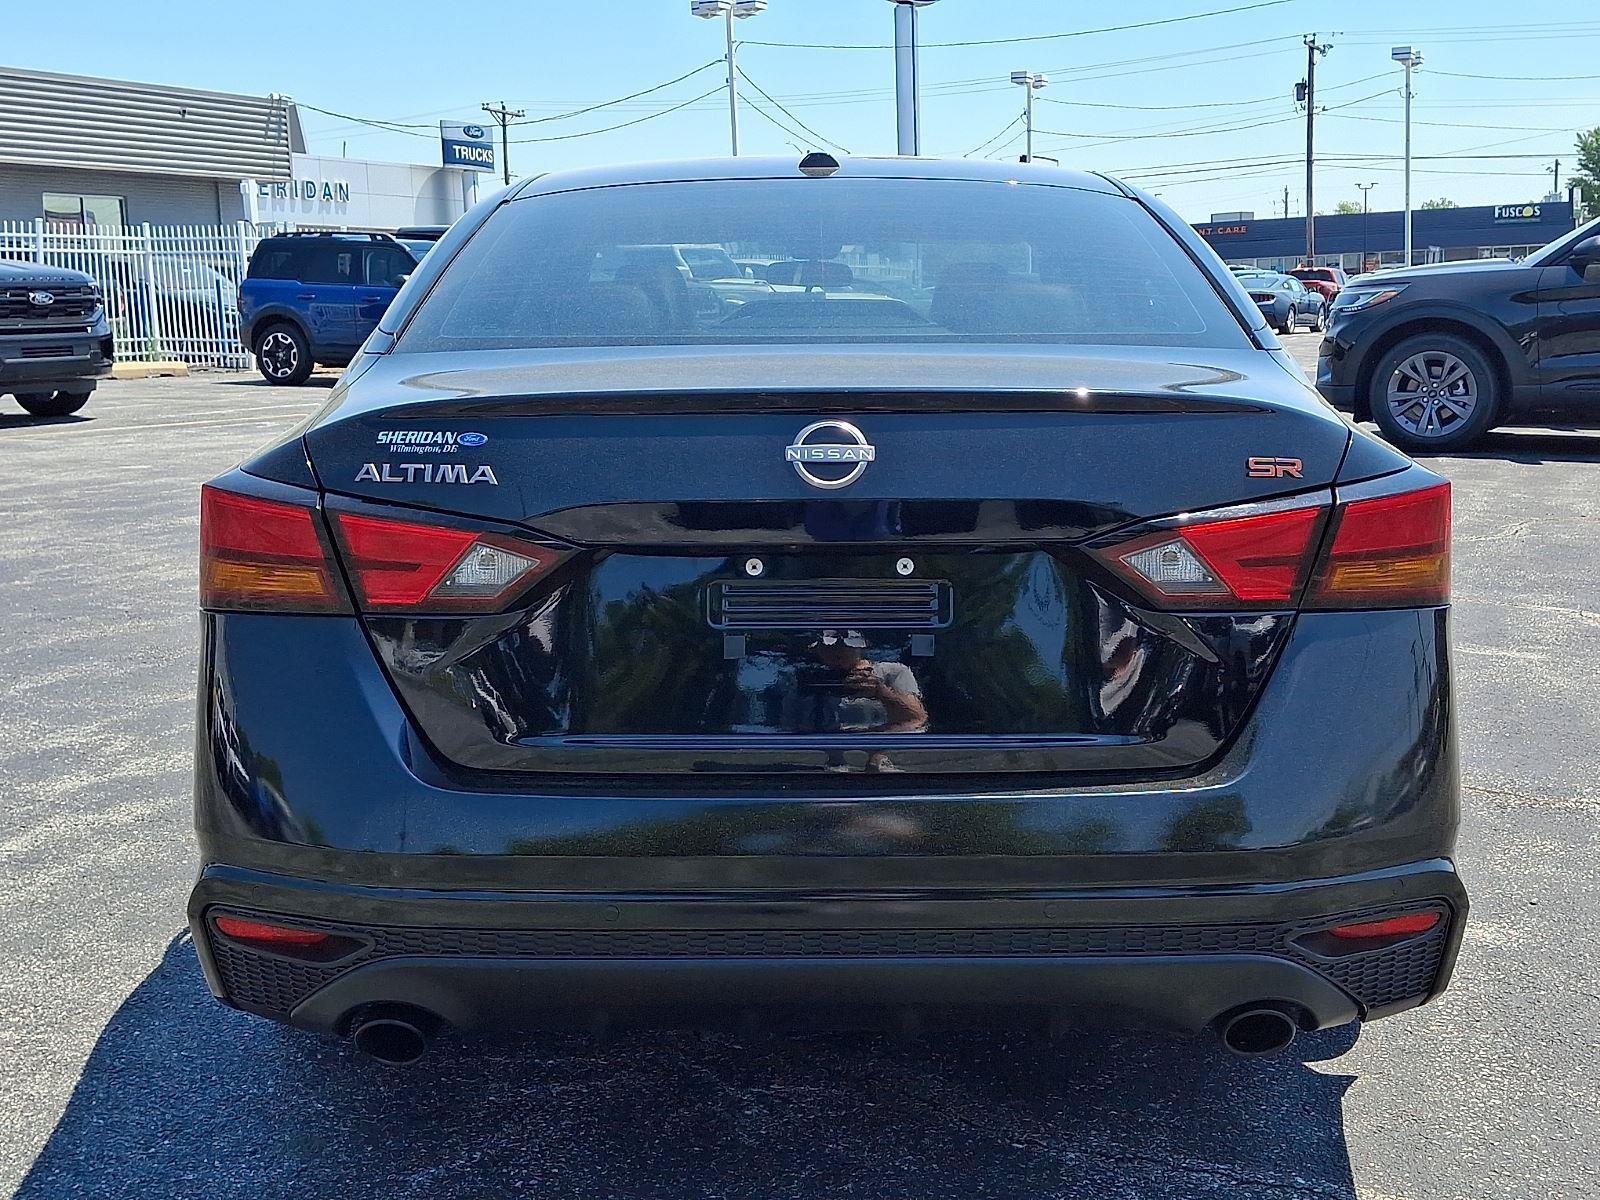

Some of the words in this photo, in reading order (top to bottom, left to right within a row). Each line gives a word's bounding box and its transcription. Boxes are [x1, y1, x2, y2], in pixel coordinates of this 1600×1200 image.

[452, 144, 494, 164] TRUCKS
[259, 179, 350, 202] ERIDAN
[1217, 225, 1248, 235] CARE
[376, 431, 458, 444] SHERIDAN
[390, 444, 442, 454] Wilmington,
[442, 444, 459, 453] DE
[787, 448, 873, 460] NISSAN
[354, 463, 498, 485] ALTIMA
[1248, 457, 1304, 478] SR
